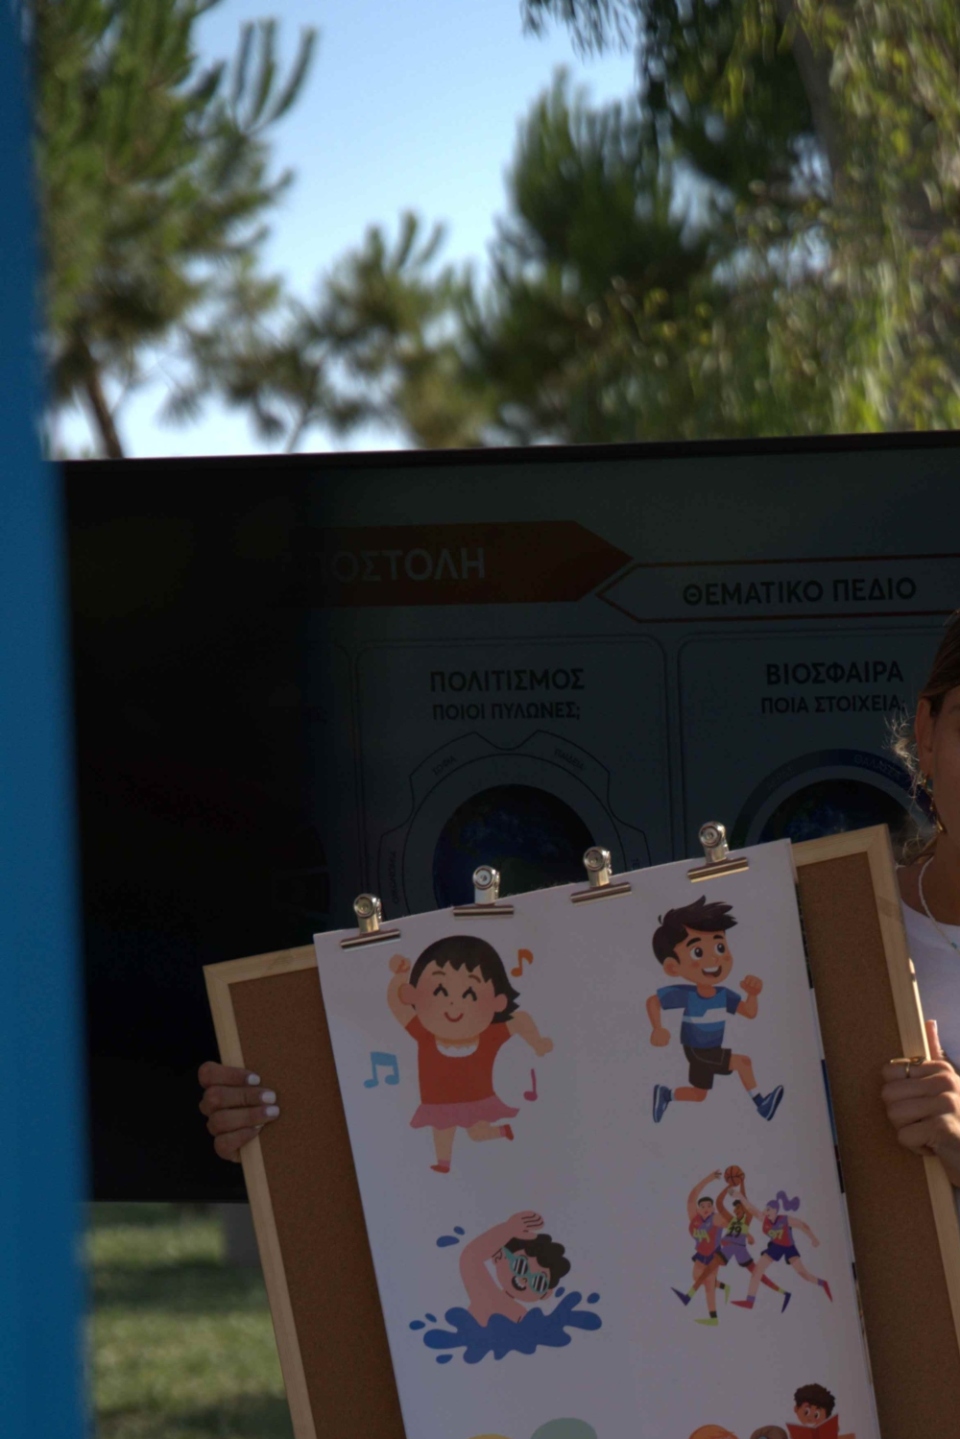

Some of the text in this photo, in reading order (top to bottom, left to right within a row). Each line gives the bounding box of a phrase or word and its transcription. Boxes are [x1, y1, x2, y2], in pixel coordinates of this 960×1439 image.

[682, 577, 917, 606] ΘΕΜΑΤΙΚΟ ΠΕΔΙΟ
[430, 669, 585, 692] ΠΟΛΙΤΙΣΜΟΣ
[766, 661, 904, 685] ΒΙΟΣΦΑΙΡΑ
[432, 701, 581, 721] ΠΟΙΟΙ ΠΥΛΩΝΕΣ;
[761, 697, 809, 714] ΠΟΙΑ
